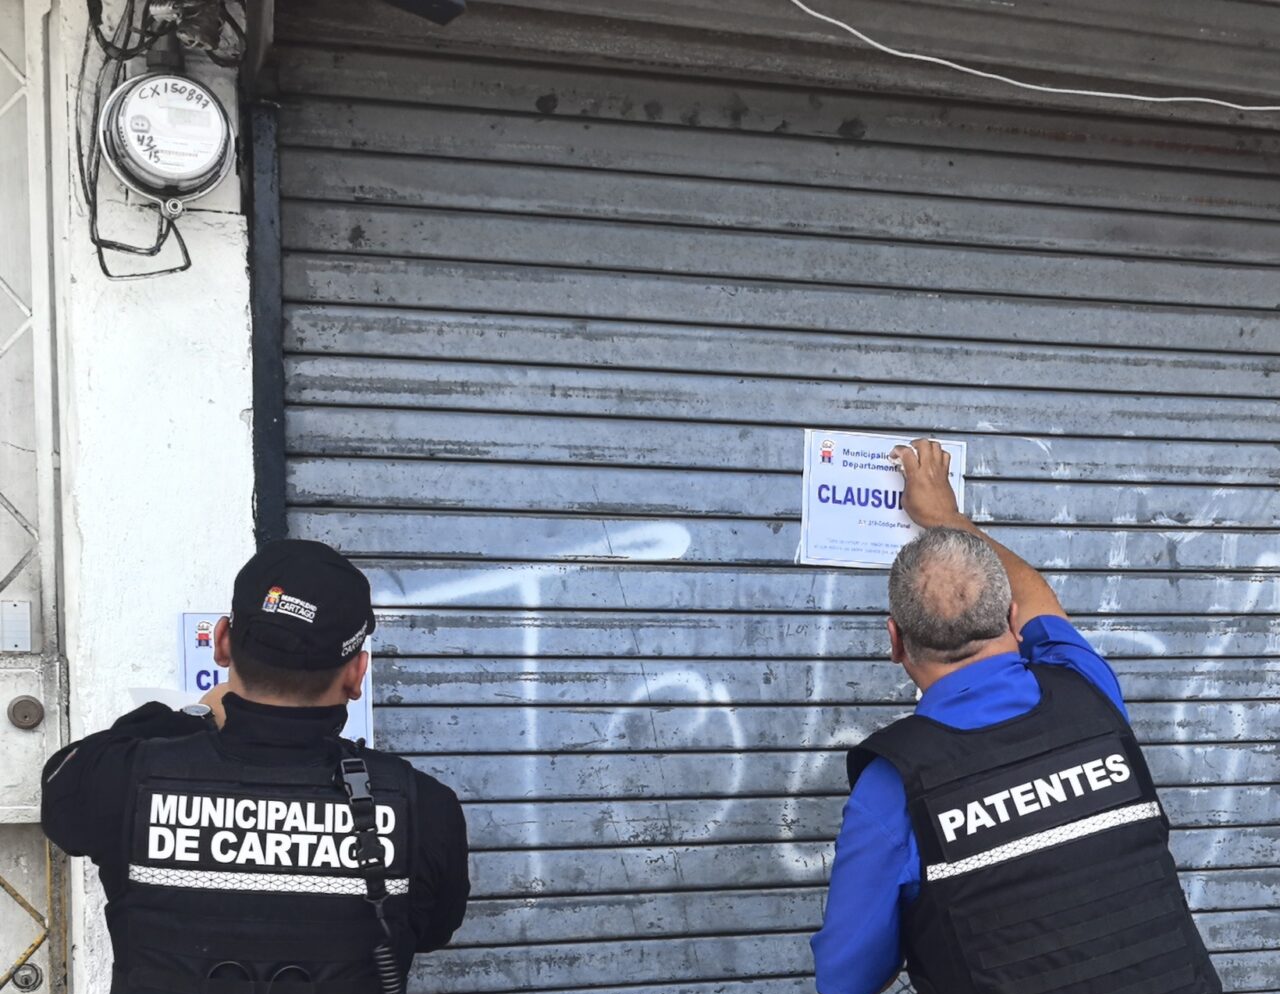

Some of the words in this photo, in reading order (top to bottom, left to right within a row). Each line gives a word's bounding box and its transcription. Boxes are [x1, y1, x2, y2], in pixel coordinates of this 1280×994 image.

[278, 601, 316, 619] CARTAGO
[149, 793, 396, 835] MUNICIPALIDD
[937, 753, 1131, 843] PATENTES
[148, 826, 201, 862] DE
